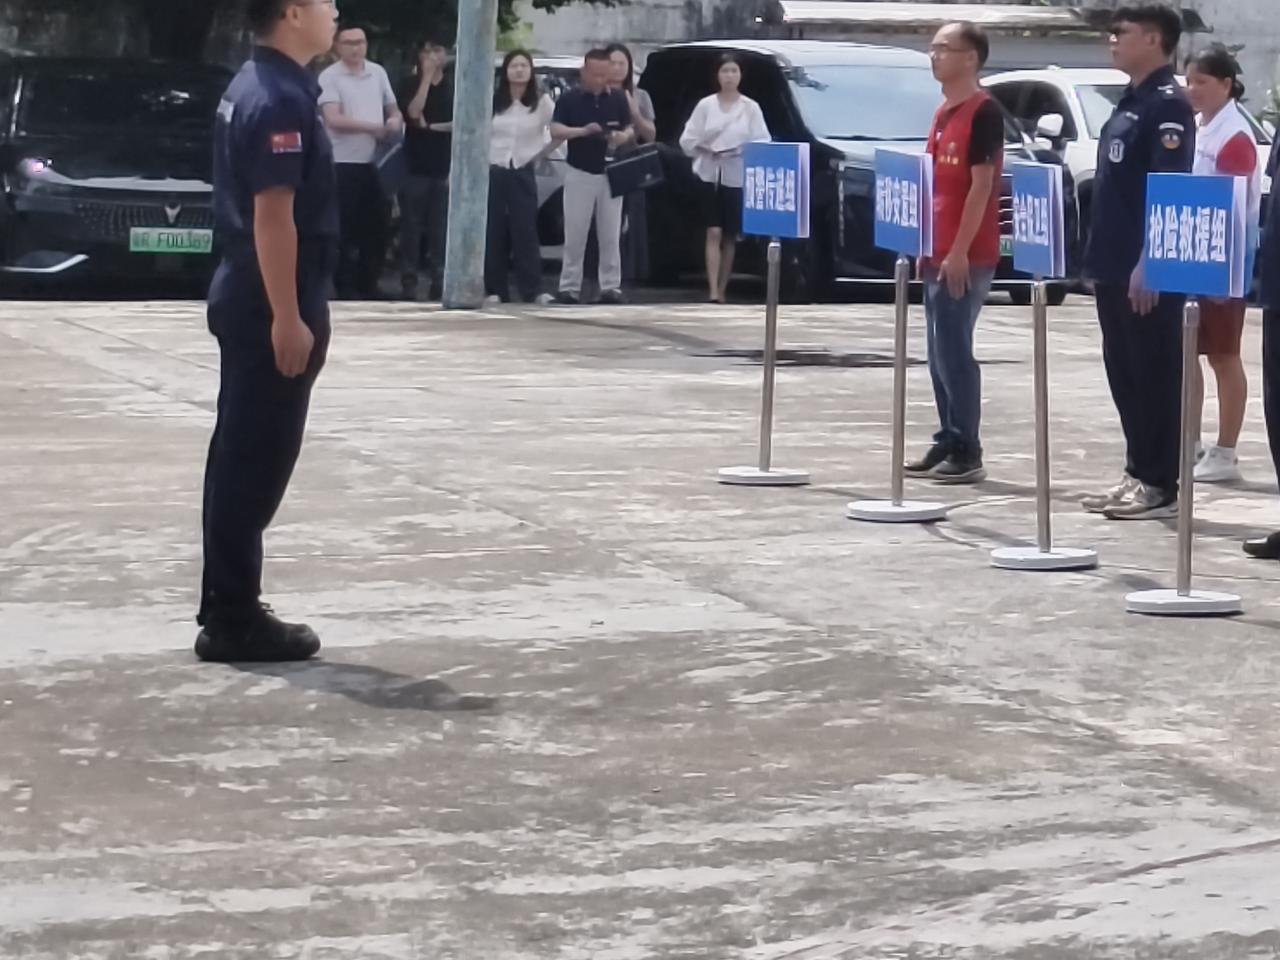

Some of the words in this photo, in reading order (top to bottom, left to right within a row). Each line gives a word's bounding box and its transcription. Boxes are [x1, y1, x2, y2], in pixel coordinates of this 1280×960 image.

[1149, 203, 1227, 263] 抢险救援组
